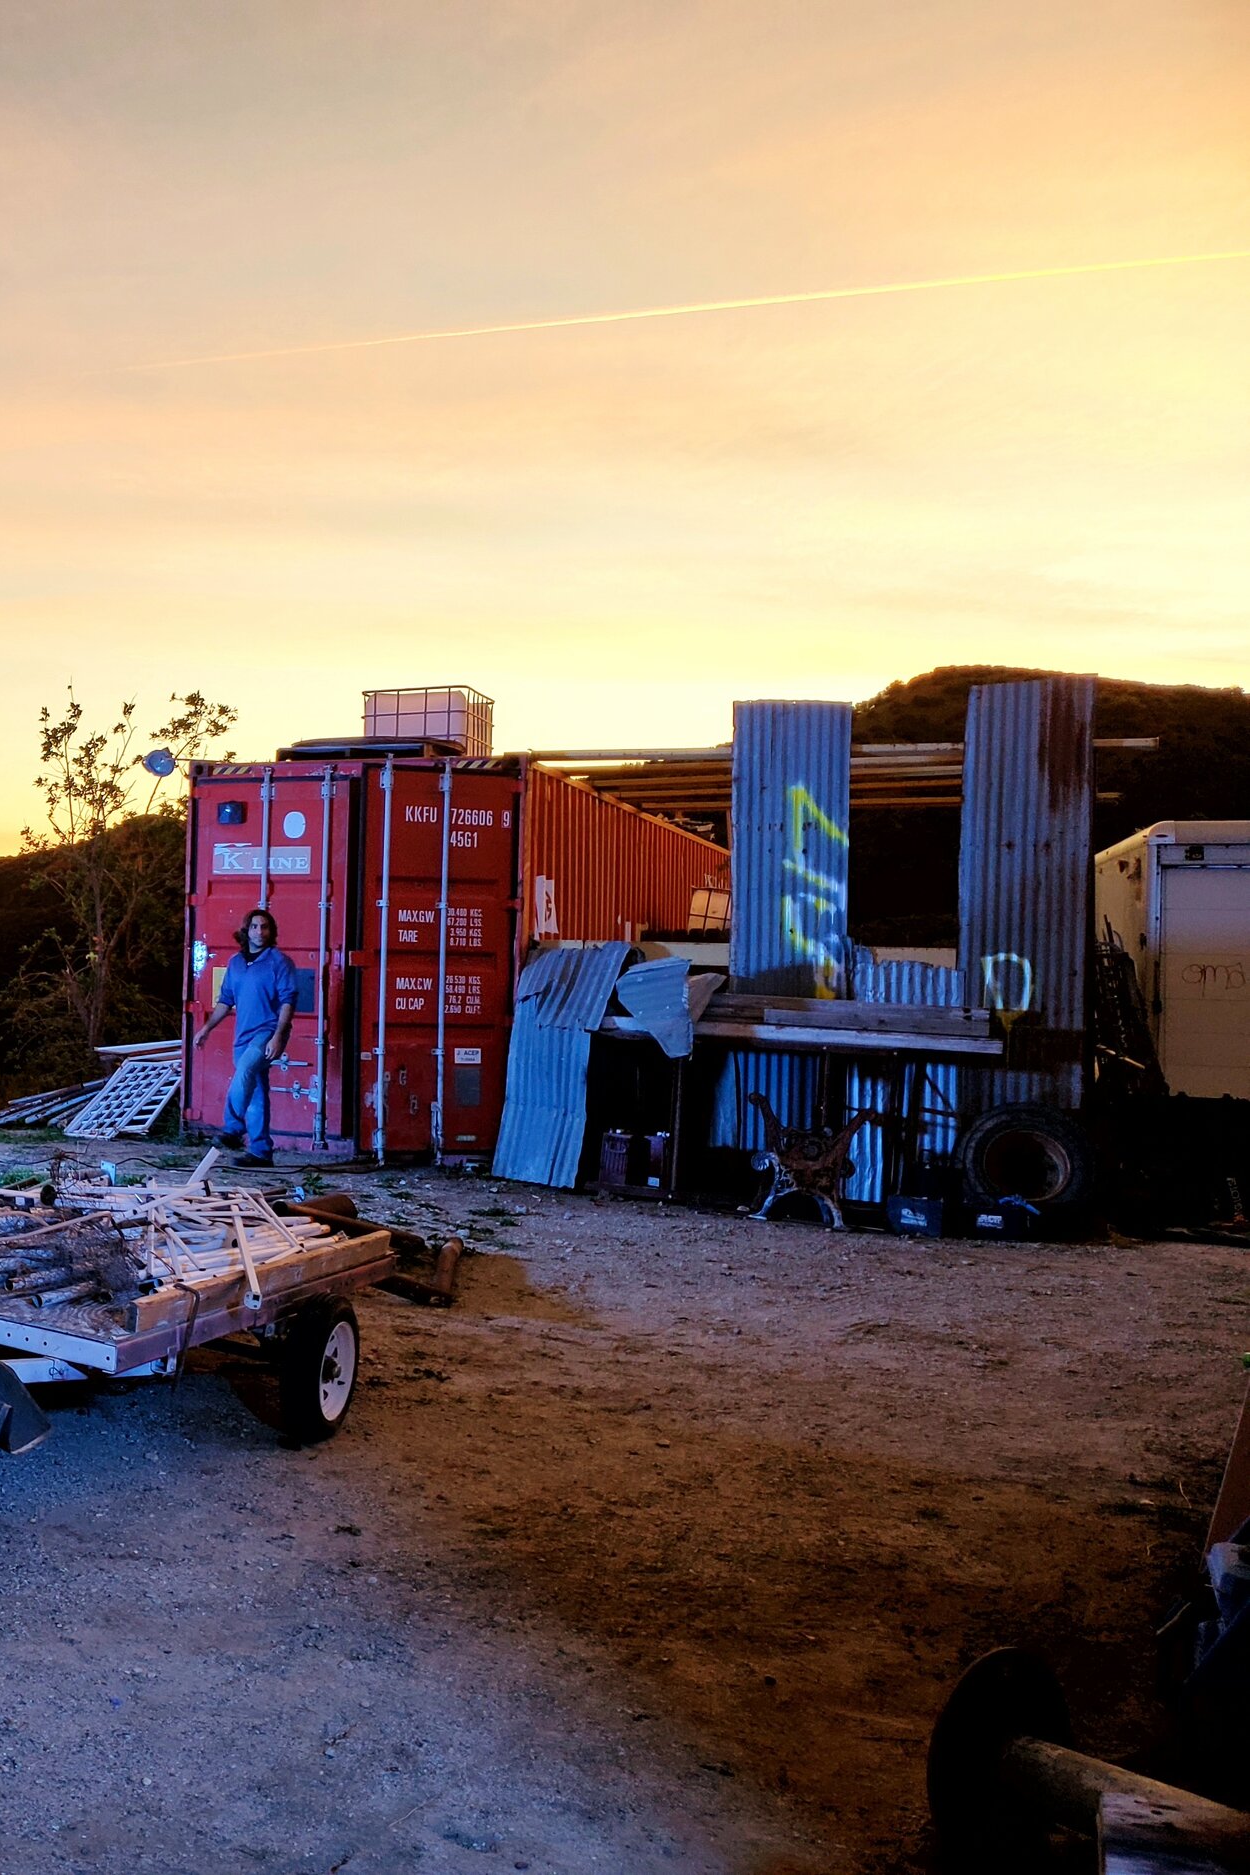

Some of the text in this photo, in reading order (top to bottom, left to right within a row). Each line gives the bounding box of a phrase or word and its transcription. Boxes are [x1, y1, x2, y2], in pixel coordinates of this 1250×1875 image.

[405, 805, 511, 828] KKFU 726606 9
[450, 831, 478, 848] 45G1
[252, 857, 308, 870] LINE
[397, 929, 419, 943] TARE
[449, 995, 461, 1004] 76.2
